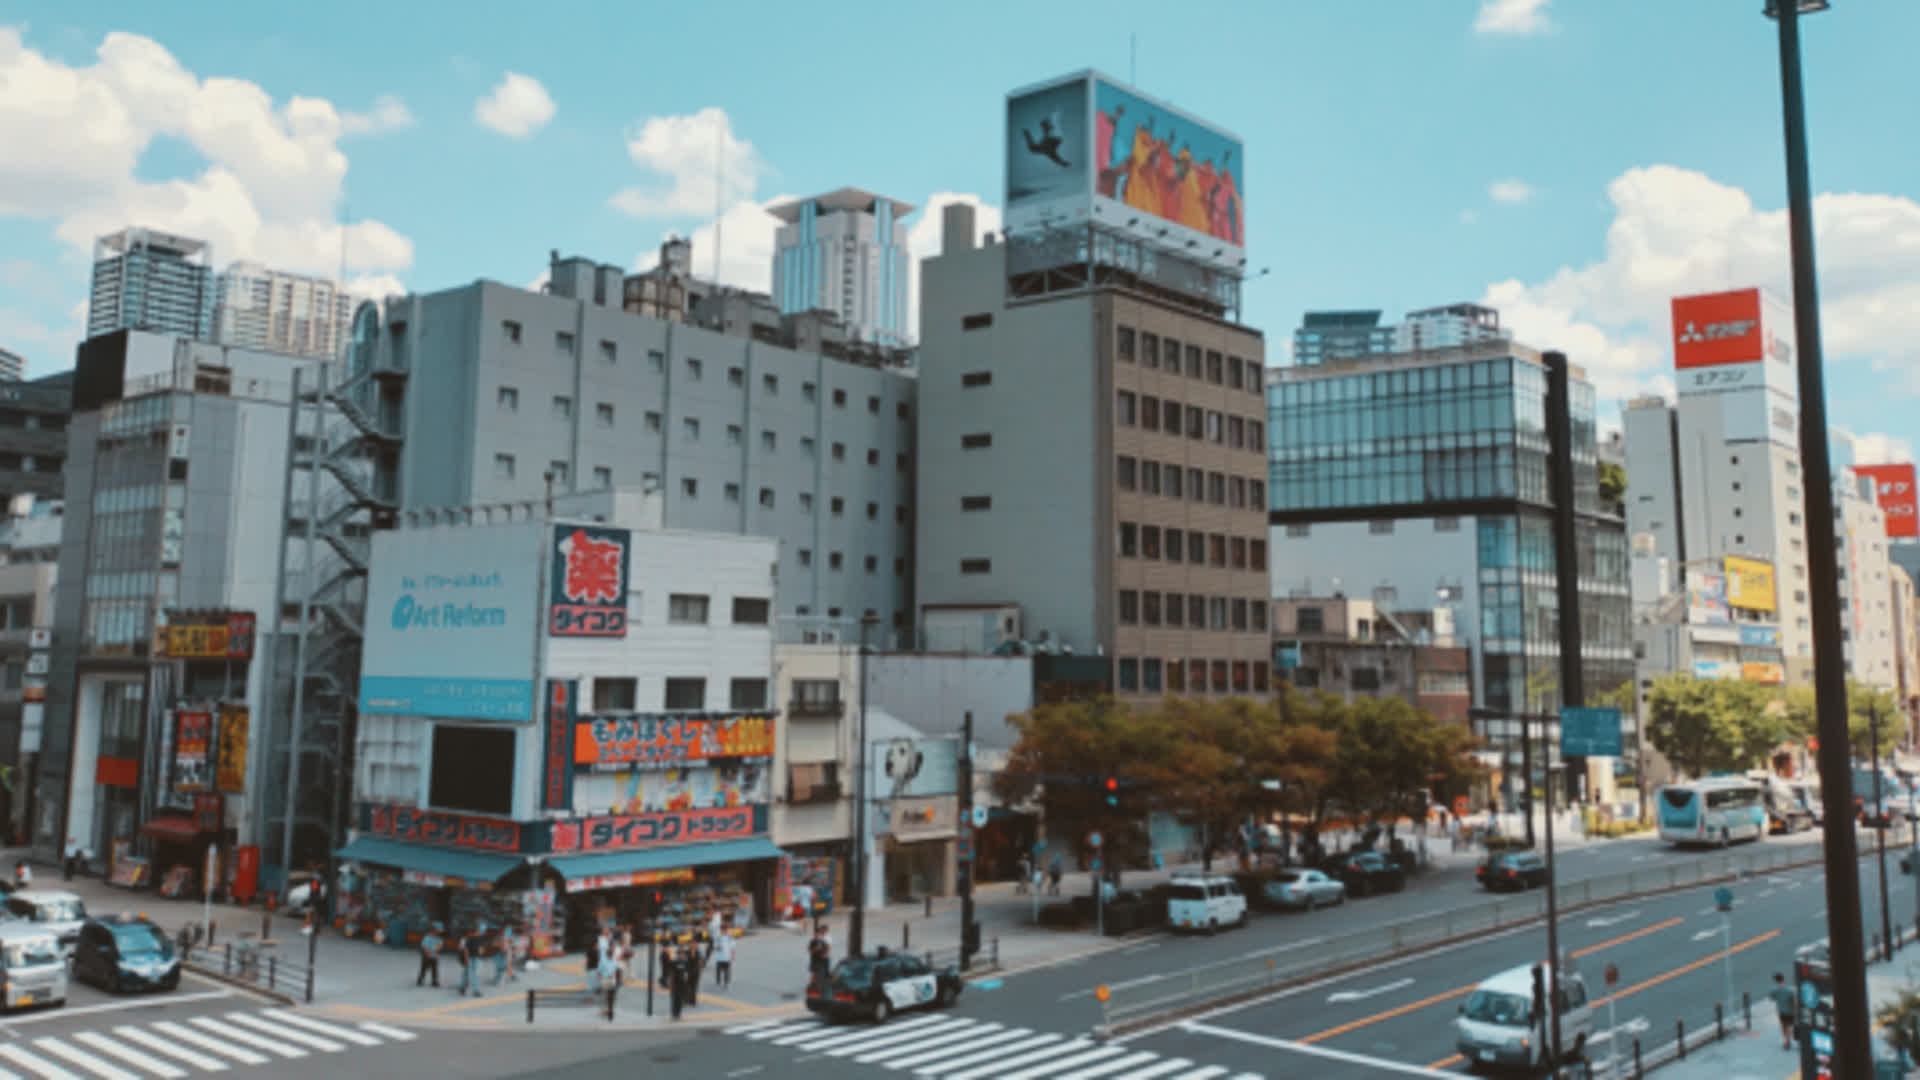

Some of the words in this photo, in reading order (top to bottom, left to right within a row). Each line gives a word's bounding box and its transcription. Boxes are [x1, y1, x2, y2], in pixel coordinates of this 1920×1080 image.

[563, 530, 623, 603] 薬
[555, 609, 625, 632] ダイコク
[592, 718, 698, 743] もみほぐし
[590, 815, 681, 847] ダイコク
